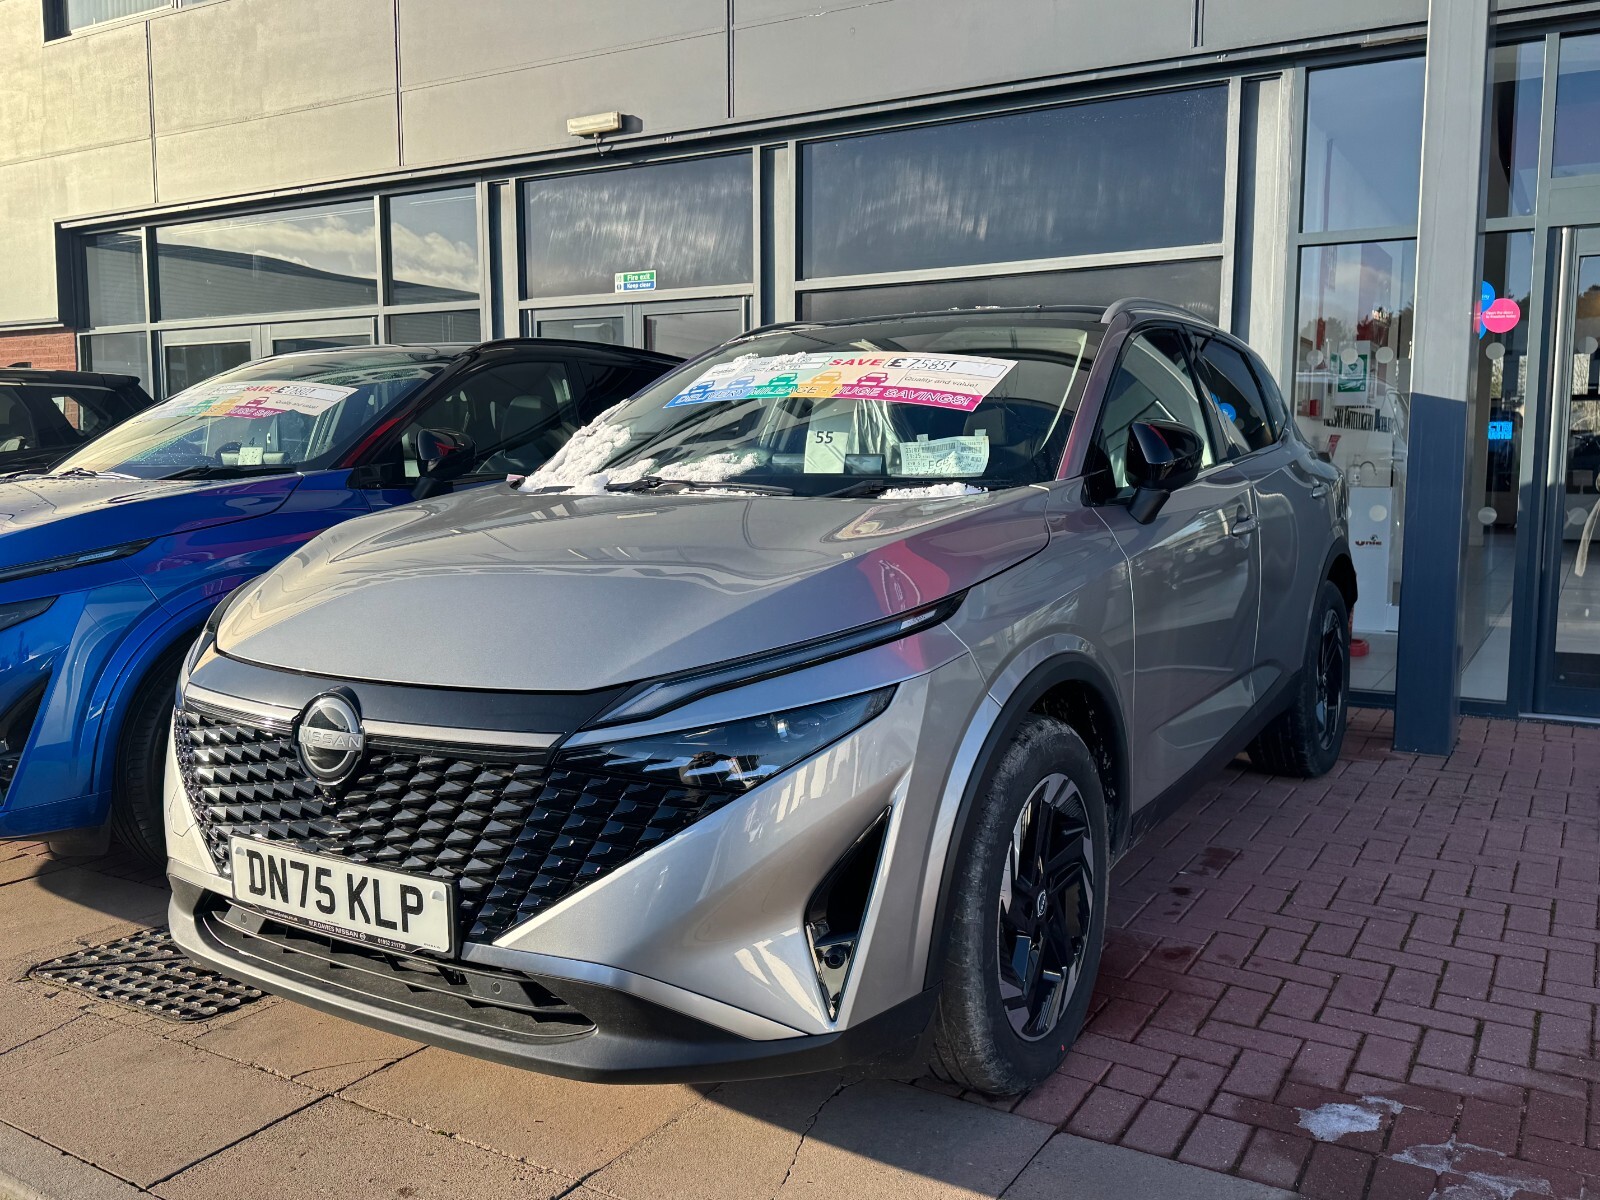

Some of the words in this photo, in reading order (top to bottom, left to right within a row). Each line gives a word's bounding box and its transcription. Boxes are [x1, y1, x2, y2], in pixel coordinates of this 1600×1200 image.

[829, 358, 885, 366] SAVE
[905, 376, 933, 384] Quality
[952, 380, 979, 388] value!
[674, 388, 746, 404] DELIVERY
[751, 386, 819, 395] MILEAGE
[831, 386, 883, 397] HUGE
[883, 389, 973, 407] SAVINGS!
[815, 431, 833, 444] 55
[300, 728, 361, 748] NISSAN
[246, 849, 336, 915] DN75
[346, 873, 424, 933] KLP
[335, 926, 359, 938] NISSAN
